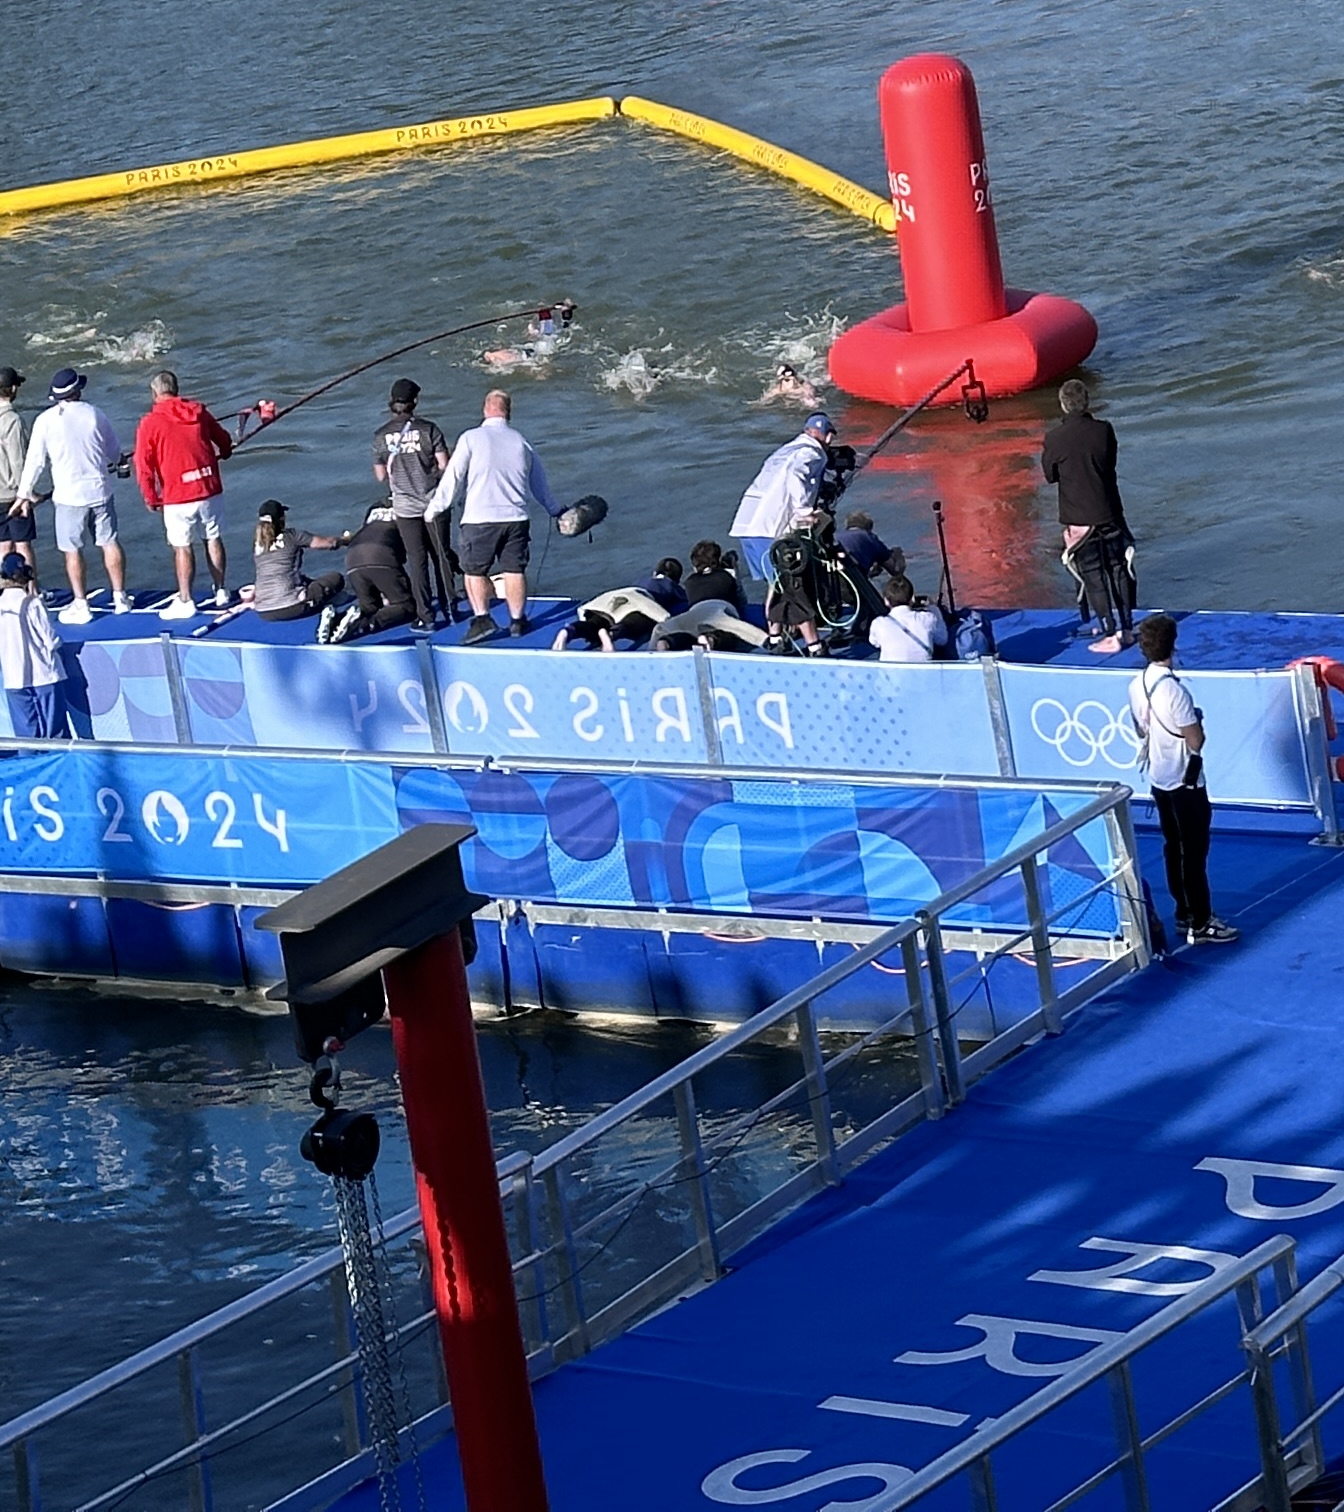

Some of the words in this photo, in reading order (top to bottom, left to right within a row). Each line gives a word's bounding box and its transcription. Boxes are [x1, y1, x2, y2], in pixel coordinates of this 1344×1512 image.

[396, 123, 452, 142] PARIS
[458, 117, 508, 134] 2024
[126, 166, 182, 185] PARIS
[188, 157, 238, 175] 2024
